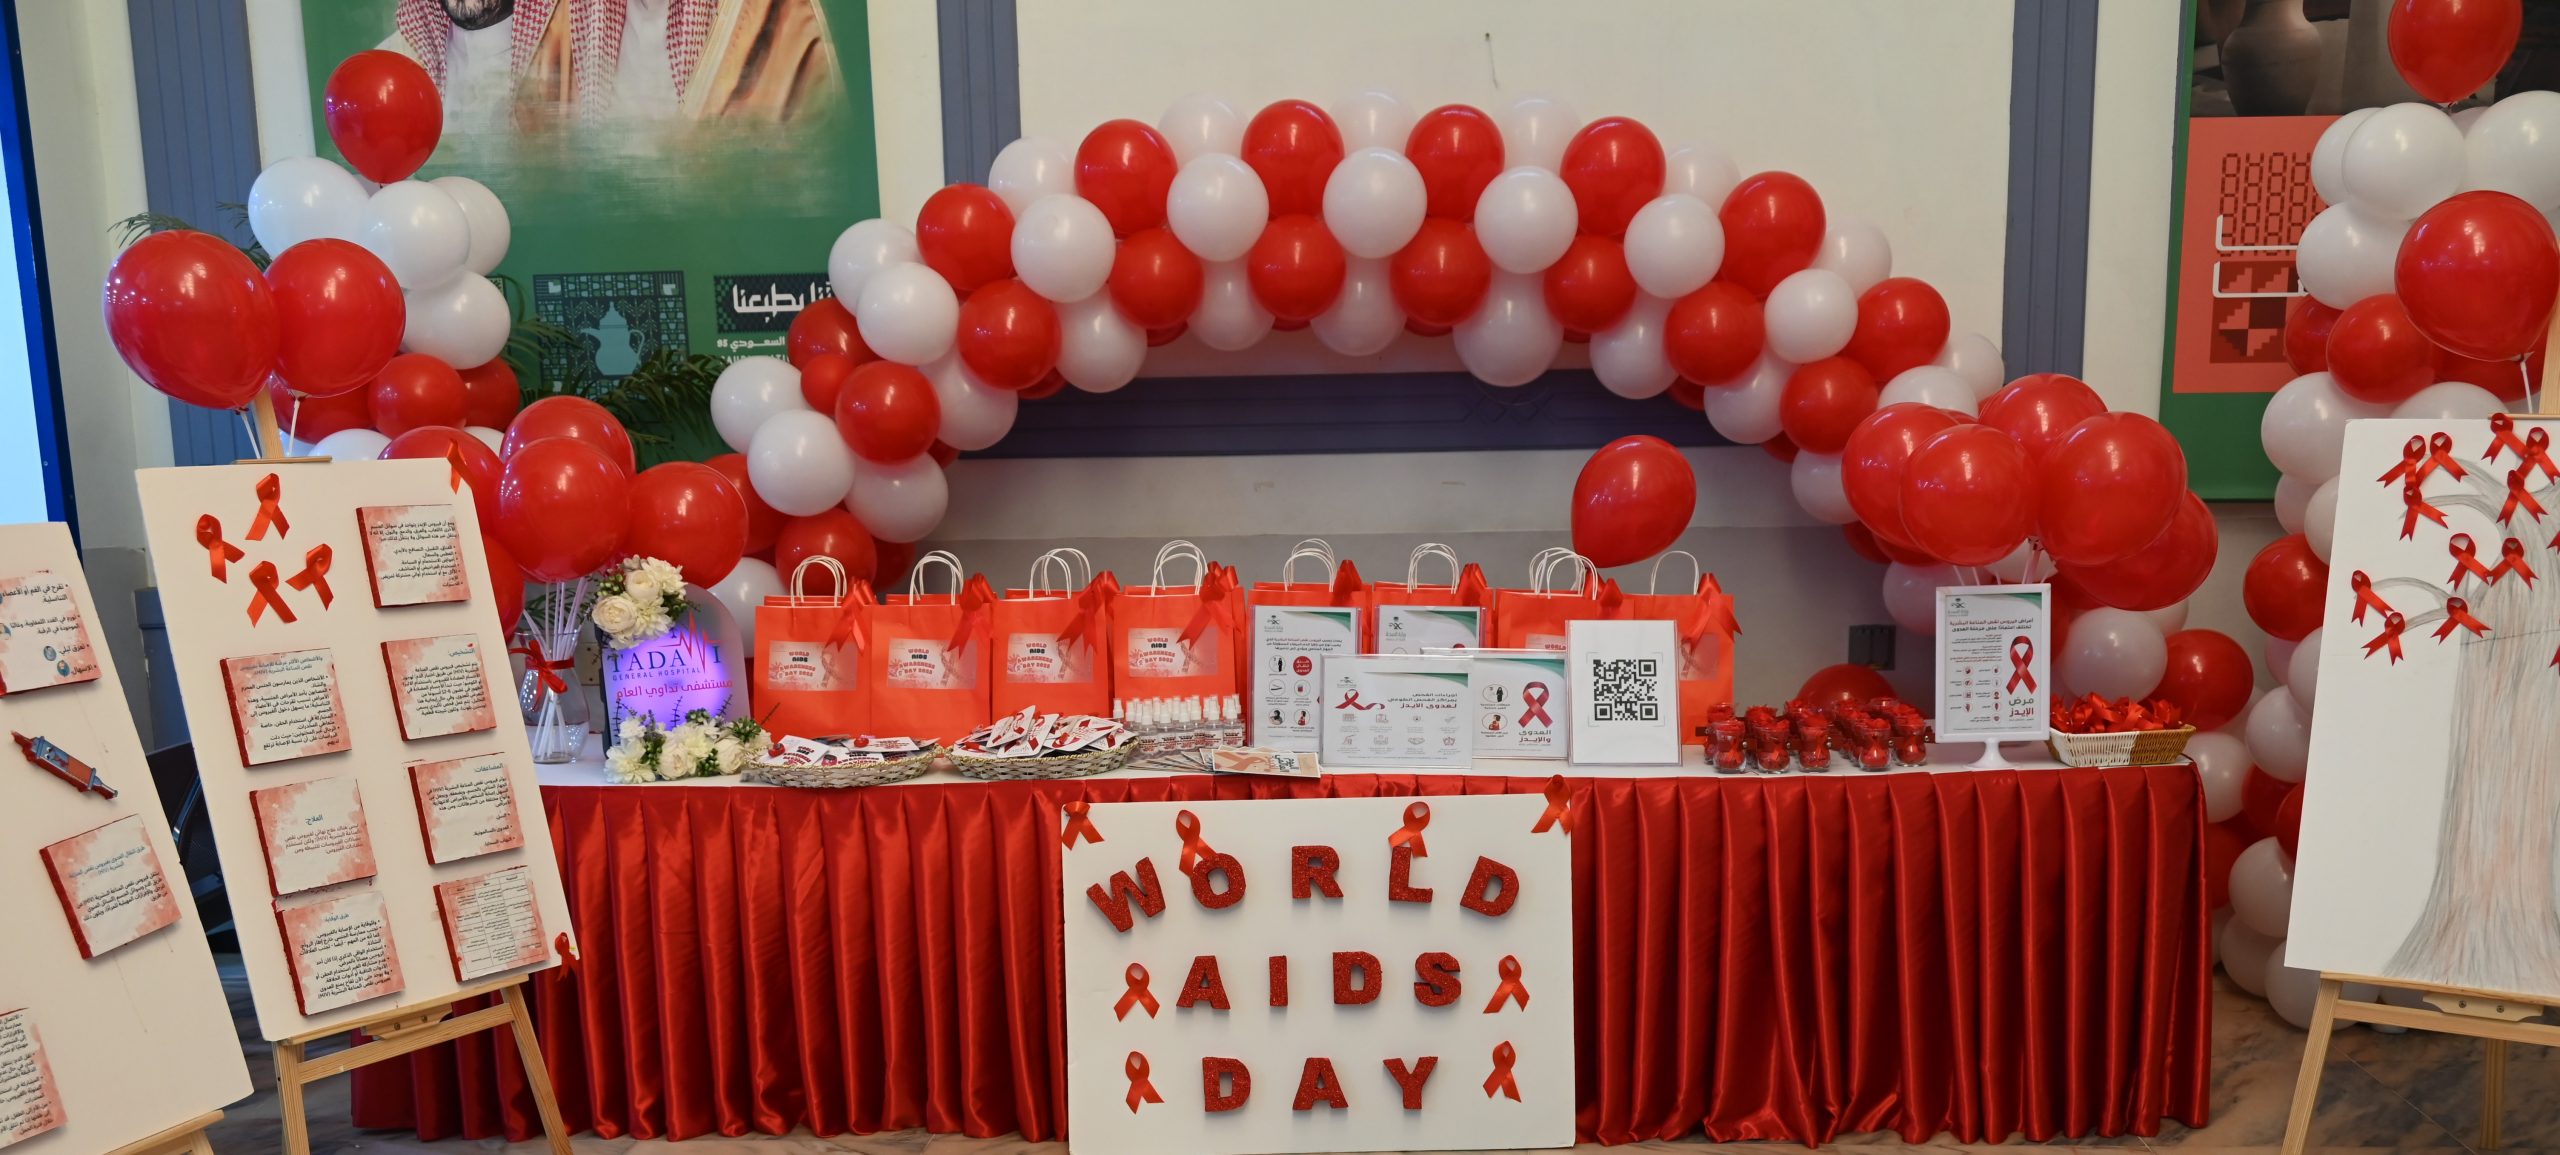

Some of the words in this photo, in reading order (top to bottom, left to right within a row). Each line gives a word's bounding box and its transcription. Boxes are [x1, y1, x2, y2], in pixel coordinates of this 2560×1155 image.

[730, 336, 785, 352] السعودي
[1139, 650, 1176, 658] AWARENESS
[899, 661, 935, 669] AWARENESS
[613, 671, 653, 681] GENERAL
[658, 668, 701, 677] HOSPITAL
[616, 686, 642, 699] العام
[646, 683, 679, 698] تداوي
[681, 679, 733, 693] مستشفى
[2008, 697, 2034, 706] مرض
[1086, 845, 1519, 932] WORLD
[1176, 951, 1462, 1010] AIDS
[1202, 1055, 1439, 1113] DAY
